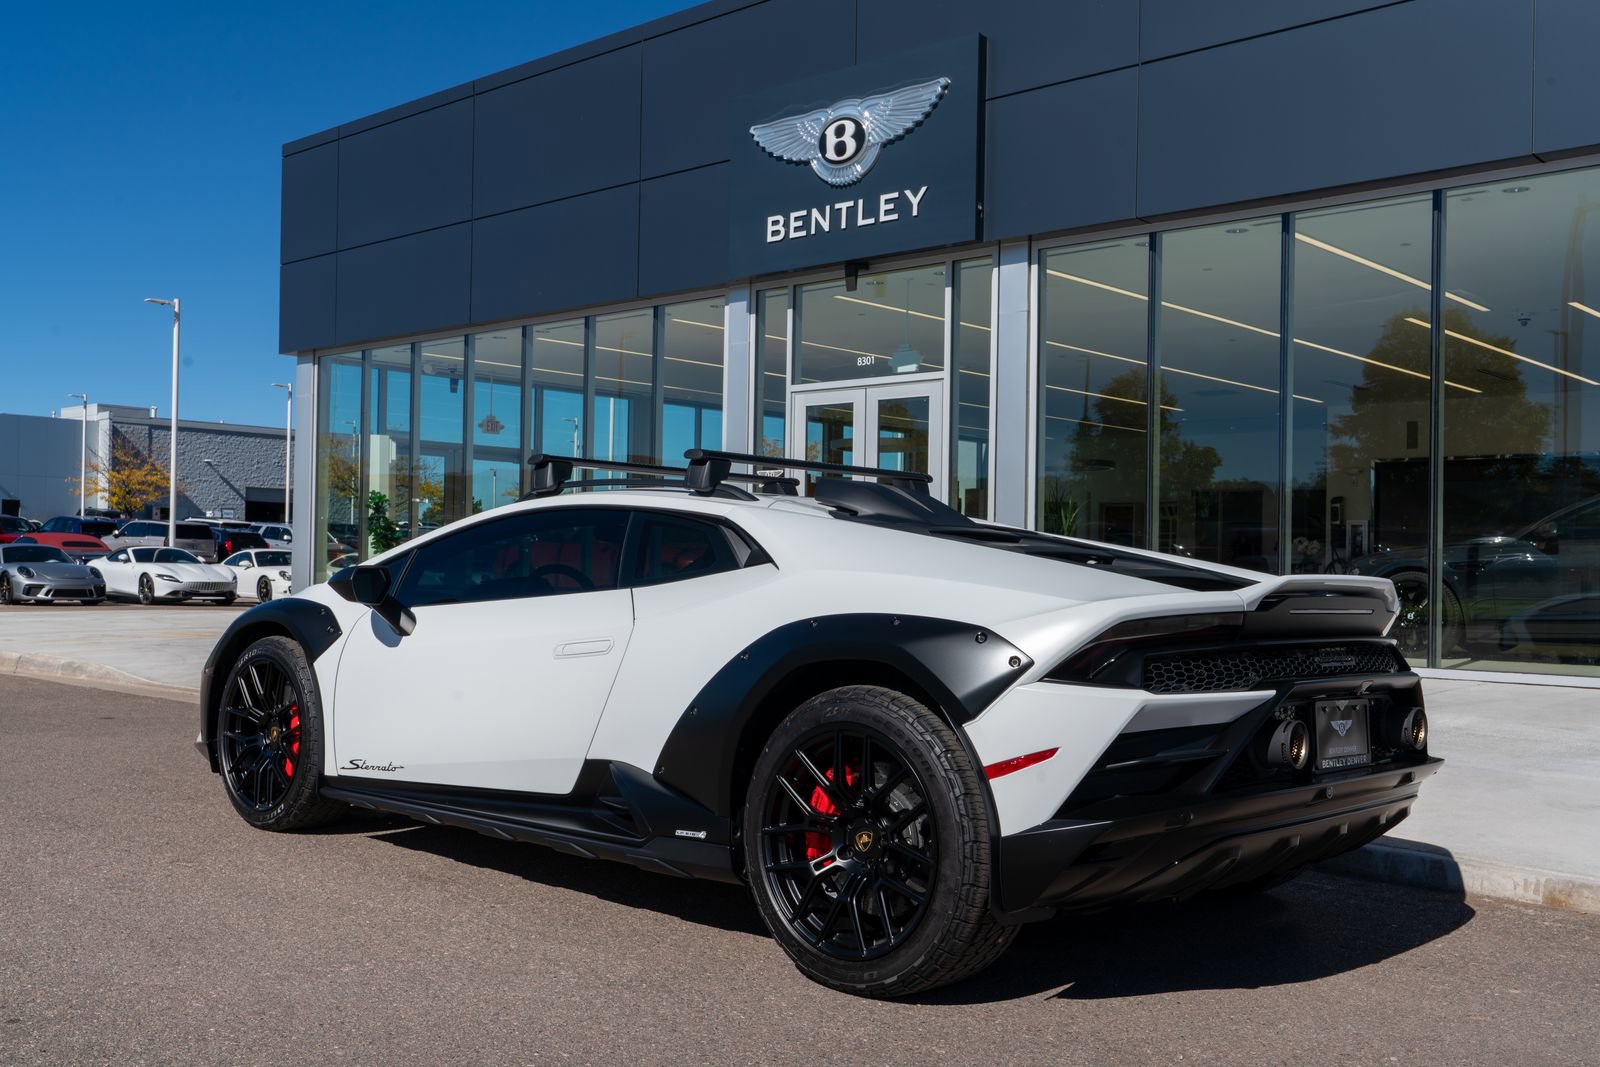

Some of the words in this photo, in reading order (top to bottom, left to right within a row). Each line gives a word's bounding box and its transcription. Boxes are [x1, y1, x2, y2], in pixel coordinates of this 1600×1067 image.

[825, 119, 857, 161] B
[766, 186, 928, 243] BENTLEY
[857, 355, 875, 366] 8301
[340, 759, 404, 772] Sterrato
[1322, 757, 1346, 769] BENTLEY
[1347, 754, 1367, 766] DENVER
